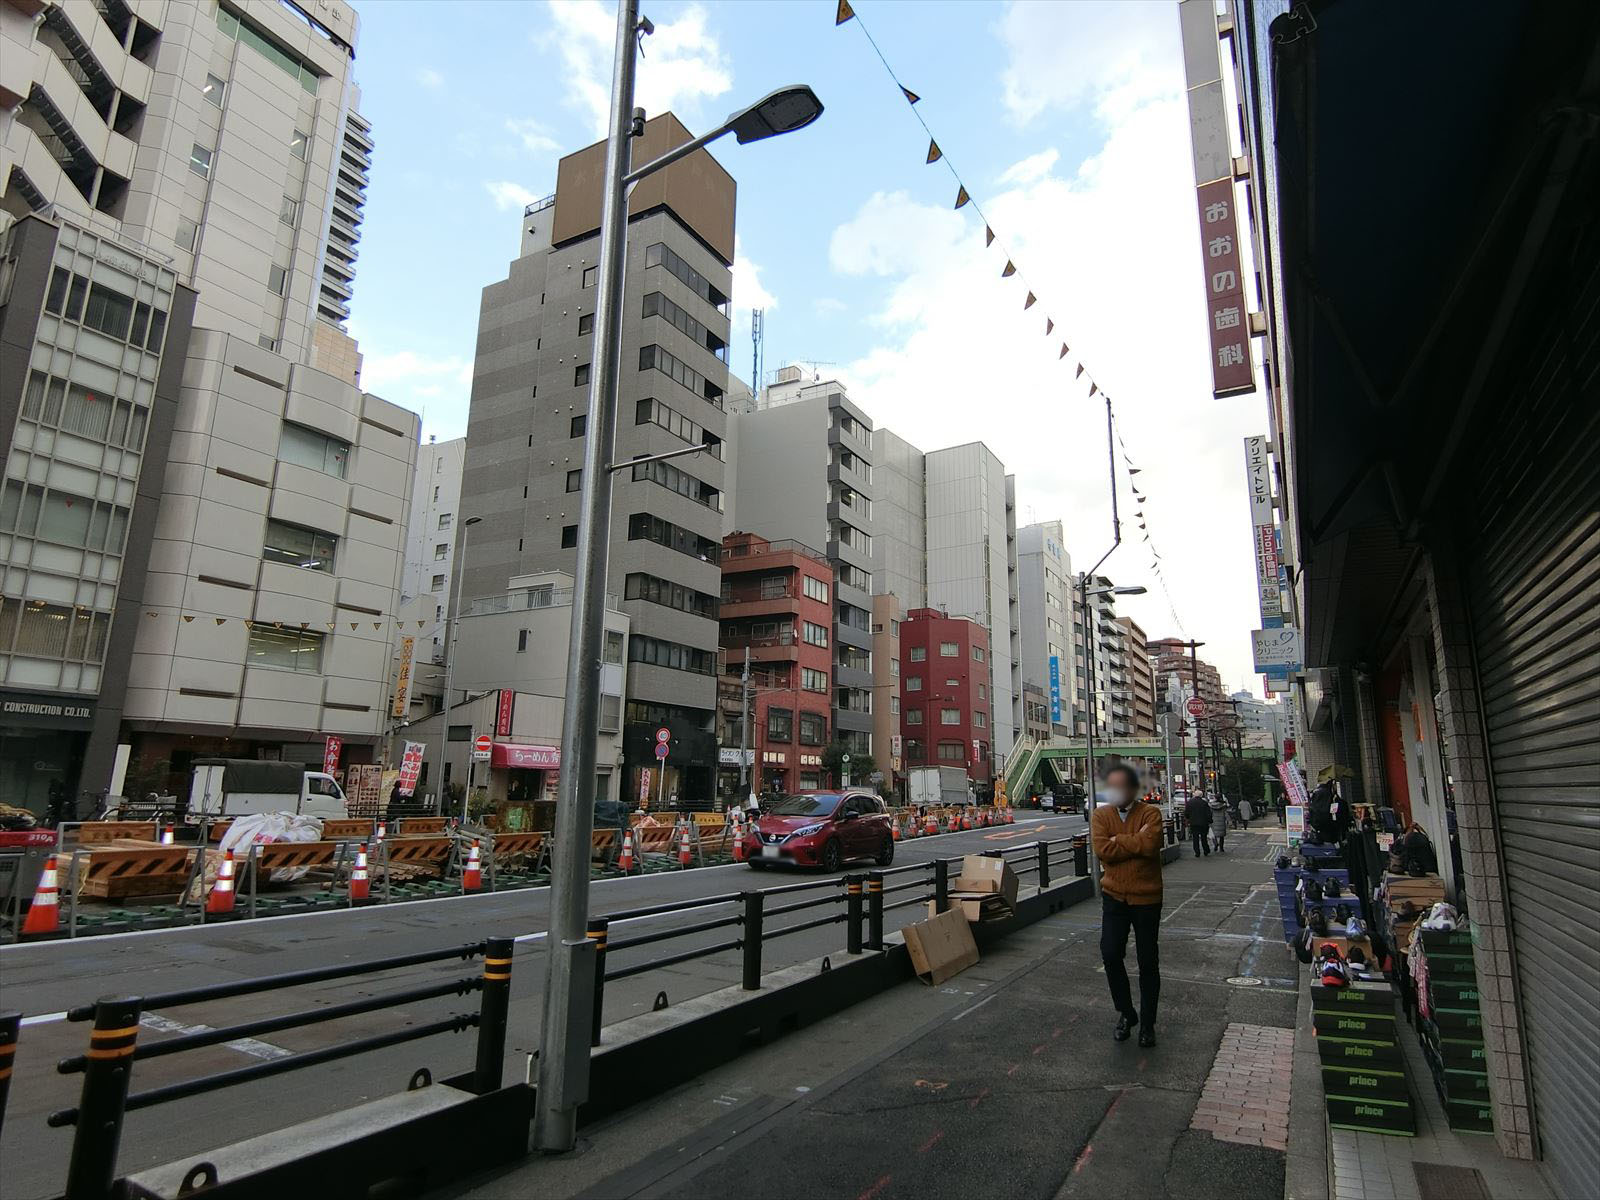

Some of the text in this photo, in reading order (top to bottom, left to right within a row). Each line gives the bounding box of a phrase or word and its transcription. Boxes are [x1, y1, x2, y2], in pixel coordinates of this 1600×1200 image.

[1204, 200, 1245, 368] おおの歯科
[1256, 640, 1279, 648] やじま
[1256, 646, 1294, 656] クリニック
[4, 702, 62, 715] CONSTRUCTION
[1337, 990, 1366, 1001] prince
[1338, 1018, 1367, 1030] prince
[1344, 1045, 1373, 1057] prince
[1349, 1075, 1378, 1086] prince
[1354, 1105, 1384, 1117] prince
